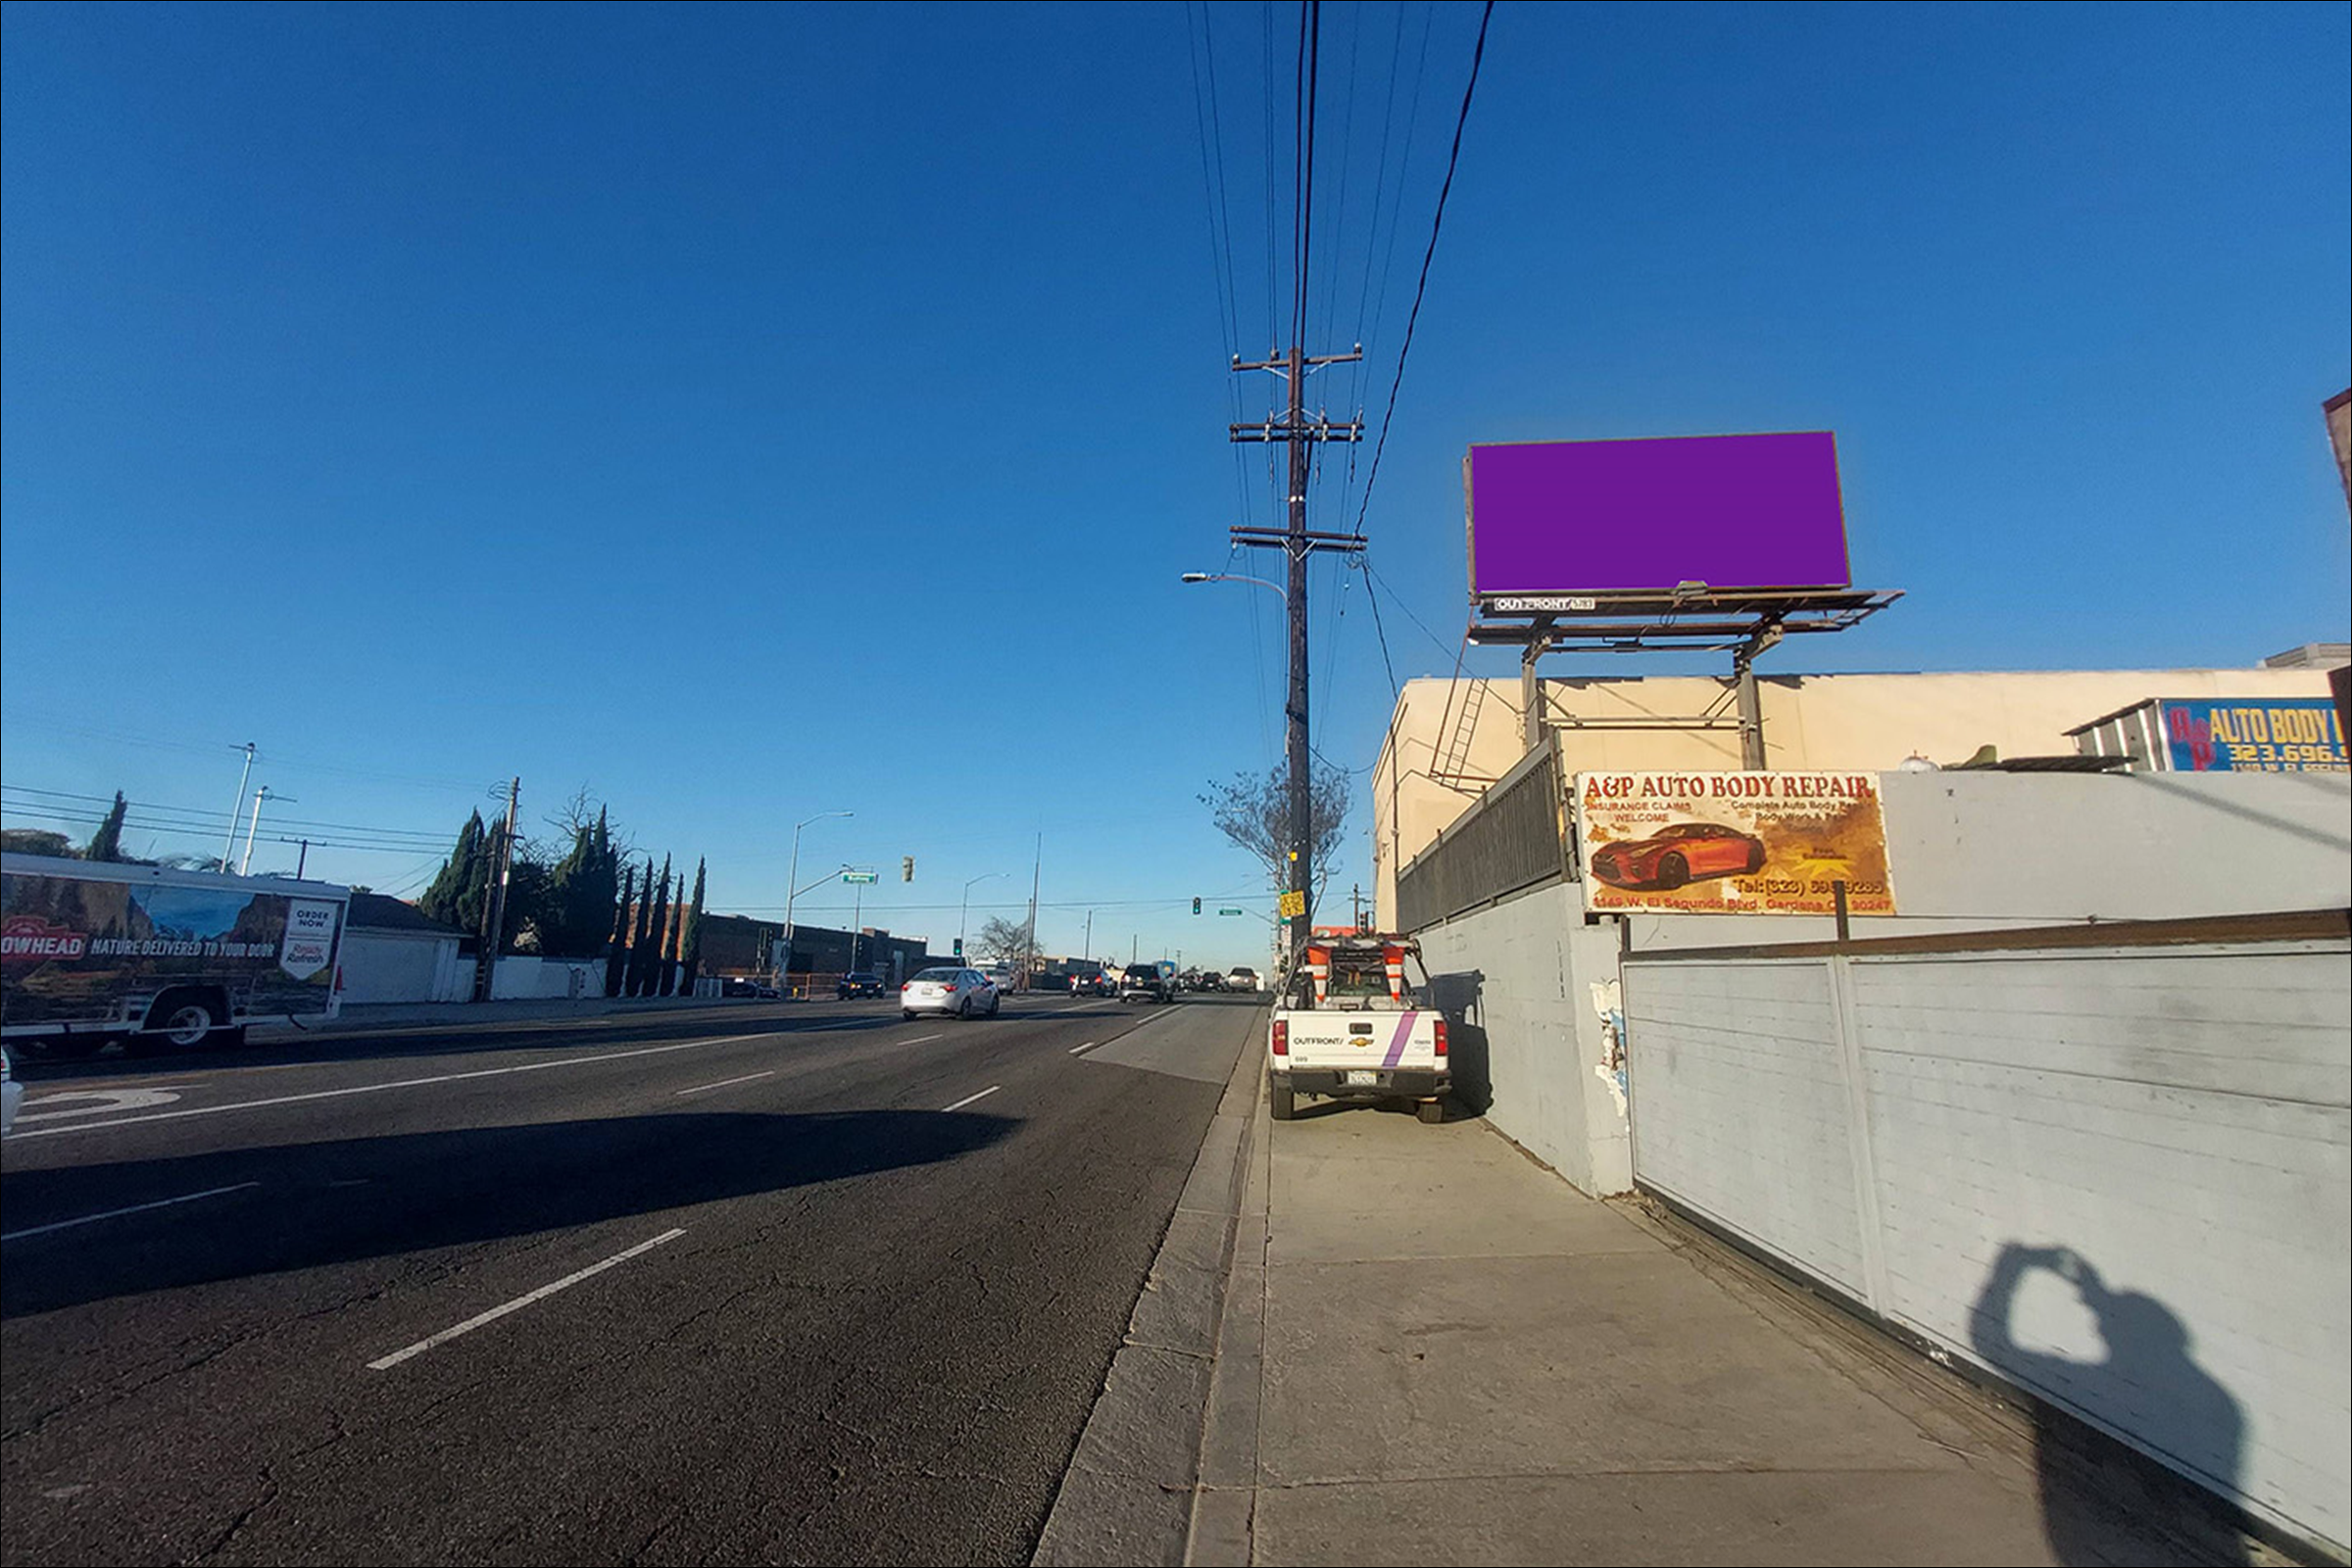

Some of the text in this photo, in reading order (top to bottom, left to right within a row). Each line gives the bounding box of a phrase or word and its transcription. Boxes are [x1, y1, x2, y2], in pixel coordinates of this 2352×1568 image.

[2210, 709, 2270, 743] AUTO
[2269, 709, 2330, 743] BODY
[1585, 776, 1873, 799] A&P AUTO BODY REPAIR
[1588, 802, 1691, 811] INSURANCE CLAIMS
[1731, 801, 1780, 810] Complete
[1782, 801, 1806, 810] Auto
[1809, 802, 1836, 812] Body
[1613, 813, 1670, 823] WELCOME
[1755, 812, 1781, 823] Body
[1783, 812, 1810, 821] Work
[1664, 897, 1724, 909] Segundo
[1727, 899, 1762, 909] Blvd.
[1766, 900, 1824, 910] Gardena
[297, 909, 329, 920] ORDER
[299, 919, 324, 928] NOW
[91, 938, 275, 958] NATURE DELIVERED TO YOUR DOOR
